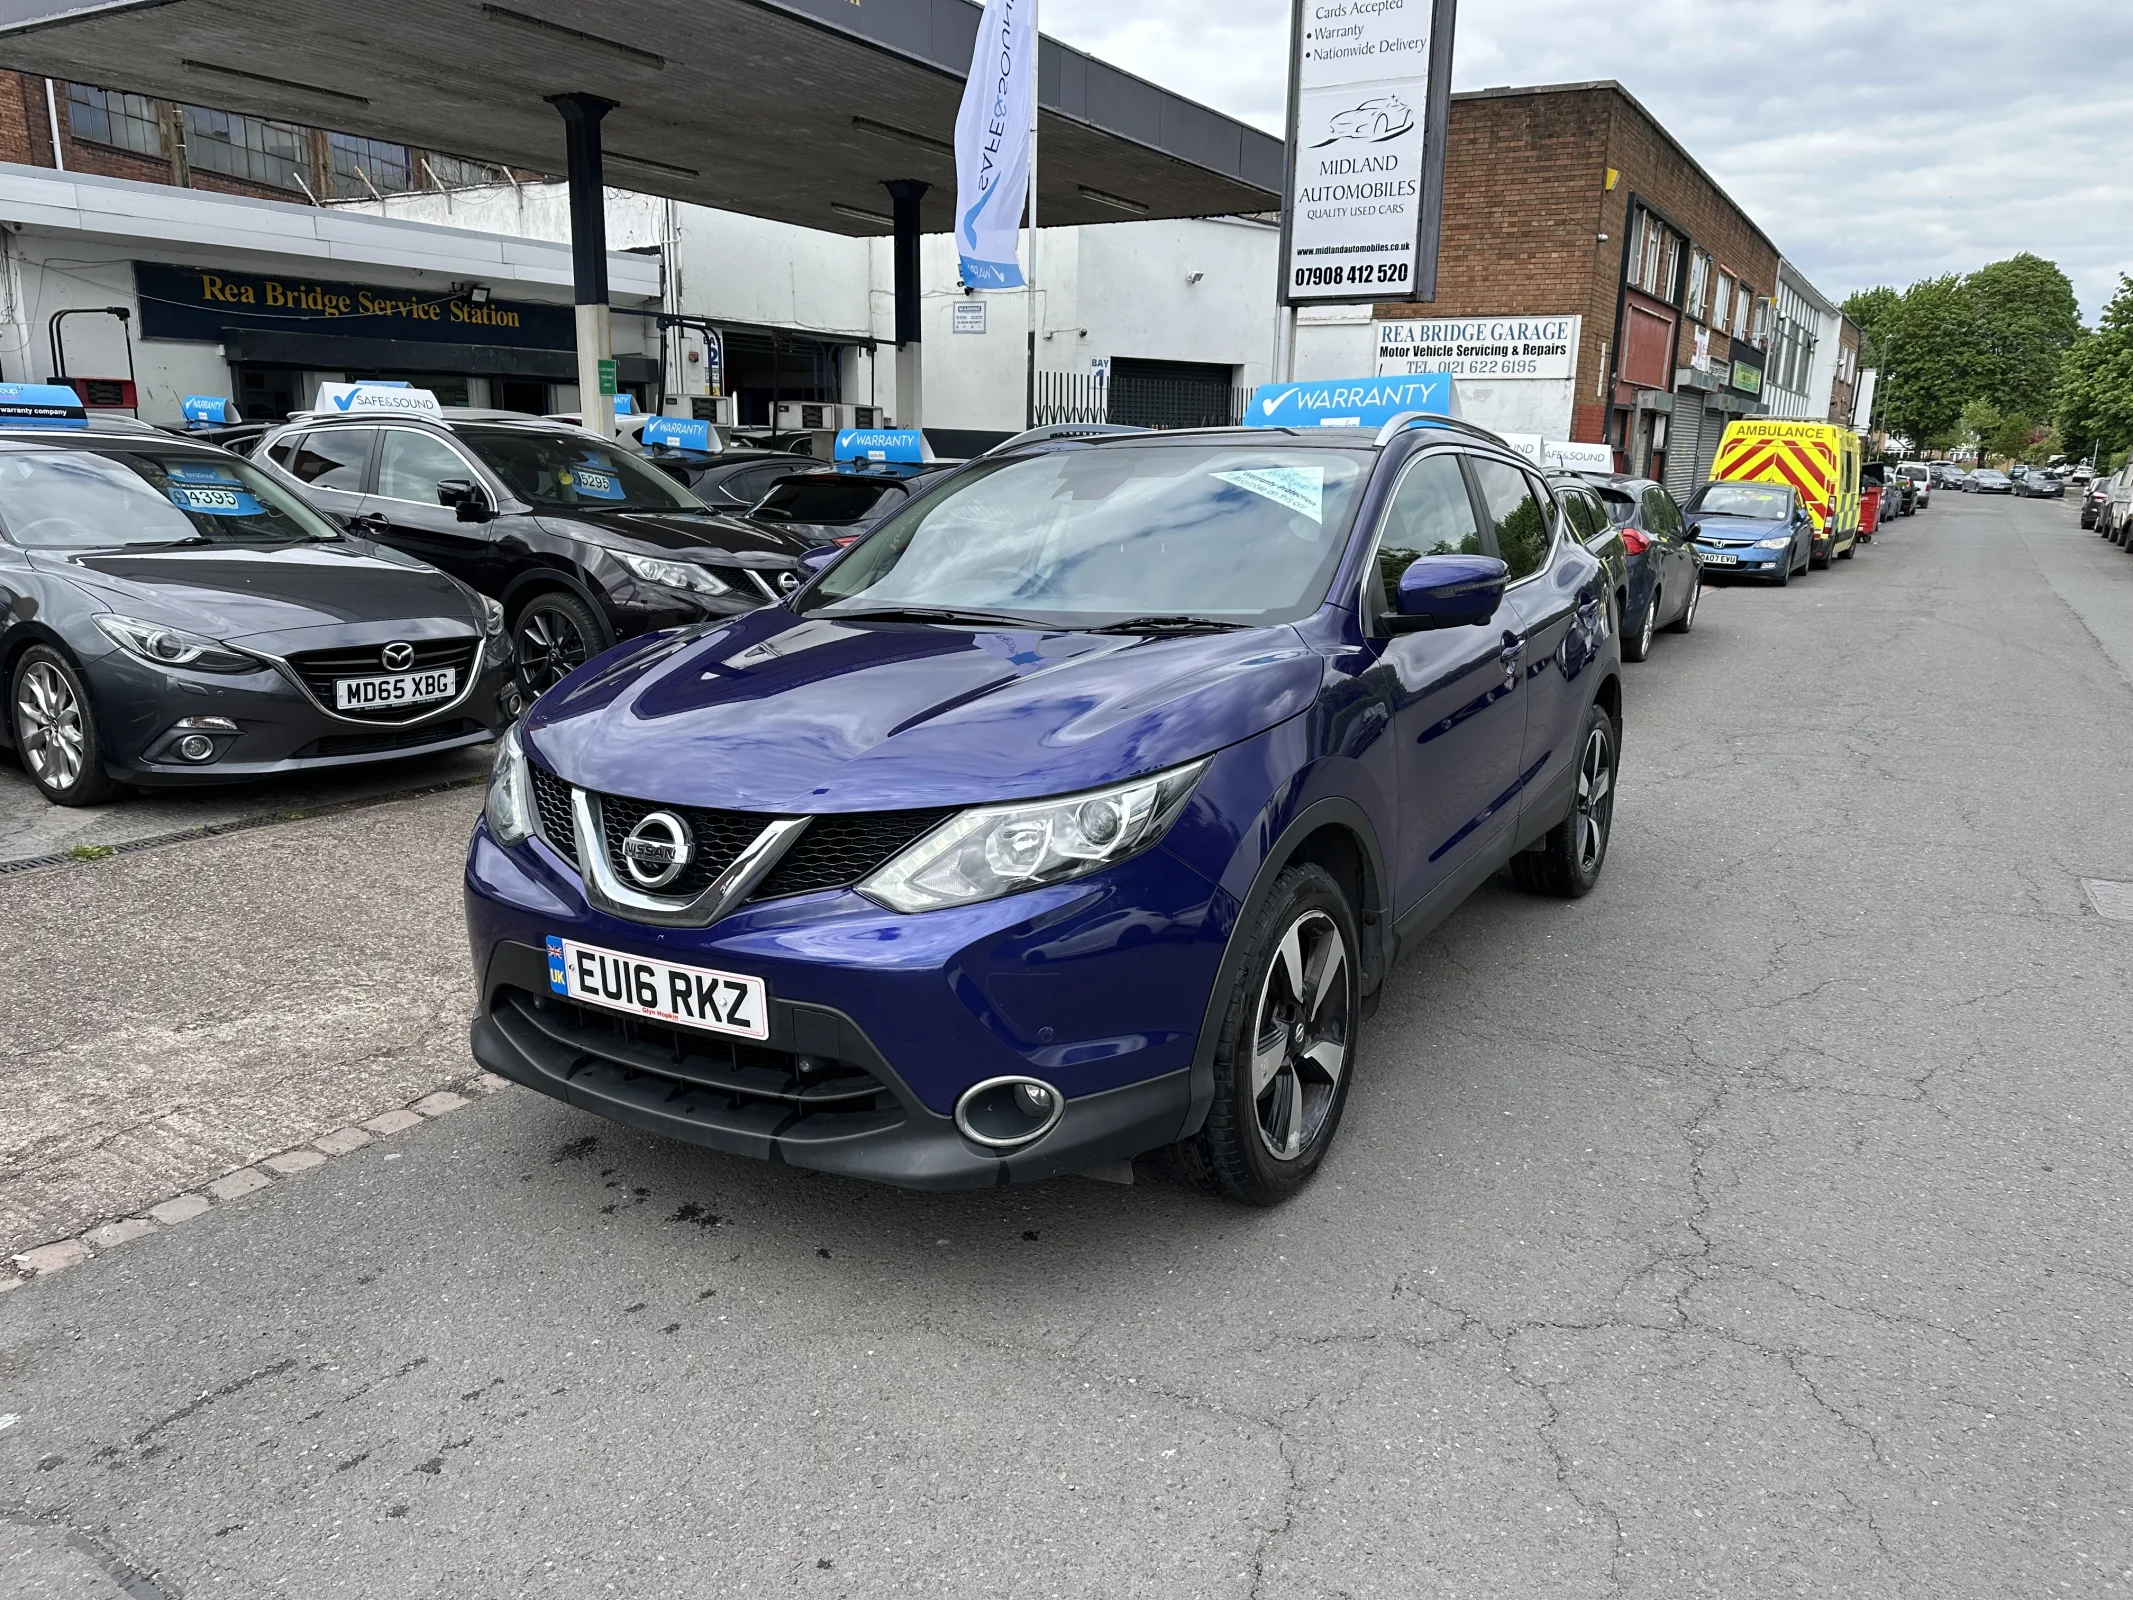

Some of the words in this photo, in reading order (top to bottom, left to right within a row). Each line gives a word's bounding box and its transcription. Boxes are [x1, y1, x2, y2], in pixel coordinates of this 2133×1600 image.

[1316, 4, 1347, 19] Cards
[1350, 0, 1403, 15] Accepted
[1315, 24, 1364, 40] Warranty
[1314, 41, 1375, 60] Nationwide
[1379, 38, 1427, 53] Delivery
[1320, 155, 1398, 175] MIDLAND
[1299, 180, 1416, 203] AUTOMOBILES
[1307, 207, 1348, 220] QUALITY
[1350, 205, 1376, 216] USED
[1378, 203, 1404, 215] CARS
[1297, 242, 1410, 256] www.midlandautomobiles.co.uk
[1295, 266, 1343, 286] 07908
[1347, 265, 1374, 284] 412
[1377, 263, 1408, 283] 520
[201, 275, 255, 304] Rea
[263, 281, 351, 318] Bridge
[358, 290, 441, 320] Service
[449, 300, 520, 327] Station
[1382, 325, 1420, 342] REA
[1420, 323, 1487, 342] BRIDGE
[1490, 321, 1568, 341] GARAGE
[1379, 345, 1409, 357] Motor
[1413, 344, 1453, 357] Vehicle
[1456, 344, 1509, 357] Servicing
[1512, 345, 1519, 355] &
[1522, 343, 1567, 356] Repairs
[1092, 359, 1109, 367] BAY
[1407, 361, 1434, 373] TEL.
[1438, 361, 1464, 373] 0121
[1469, 360, 1498, 373] 622
[1501, 360, 1537, 373] 6195
[1096, 369, 1104, 386] 1
[356, 395, 434, 410] SAFE&SOUND
[1298, 383, 1438, 410] WARRANTY
[0, 407, 32, 415] warranty
[34, 408, 67, 416] company
[193, 400, 222, 410] WARRANTY
[660, 422, 704, 436] WARRANTY
[1736, 426, 1824, 438] AMBULANCE
[856, 434, 914, 447] WARRANTY
[1545, 450, 1605, 462] AFE&SOUND
[580, 474, 609, 489] 5295
[189, 491, 236, 505] 4395
[347, 679, 405, 704] MD65
[412, 673, 448, 697] XBG
[626, 841, 676, 859] NISSAN
[550, 967, 566, 985] UK
[576, 950, 658, 1009] EU16
[668, 970, 751, 1028] RKZ
[642, 1007, 656, 1016] Glyn
[657, 1010, 679, 1020] Hopkin
